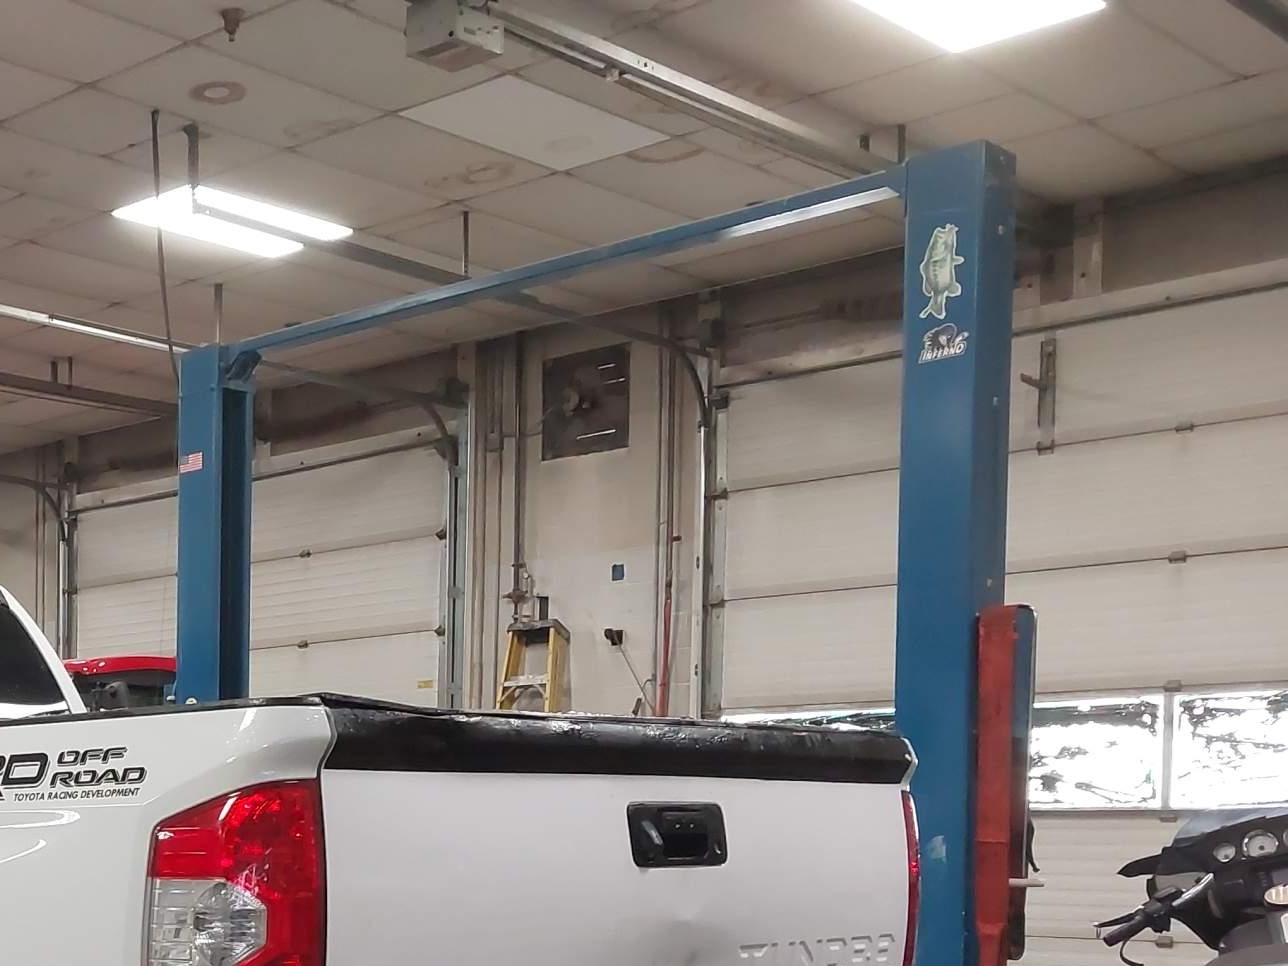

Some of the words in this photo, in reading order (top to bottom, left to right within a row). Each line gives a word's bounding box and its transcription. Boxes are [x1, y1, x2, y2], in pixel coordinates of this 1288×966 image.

[57, 746, 128, 766] OFF
[50, 766, 147, 788] ROAD
[14, 791, 45, 802] TOYOTA
[47, 790, 79, 800] RACING
[80, 787, 141, 799] DEVELOPMENT
